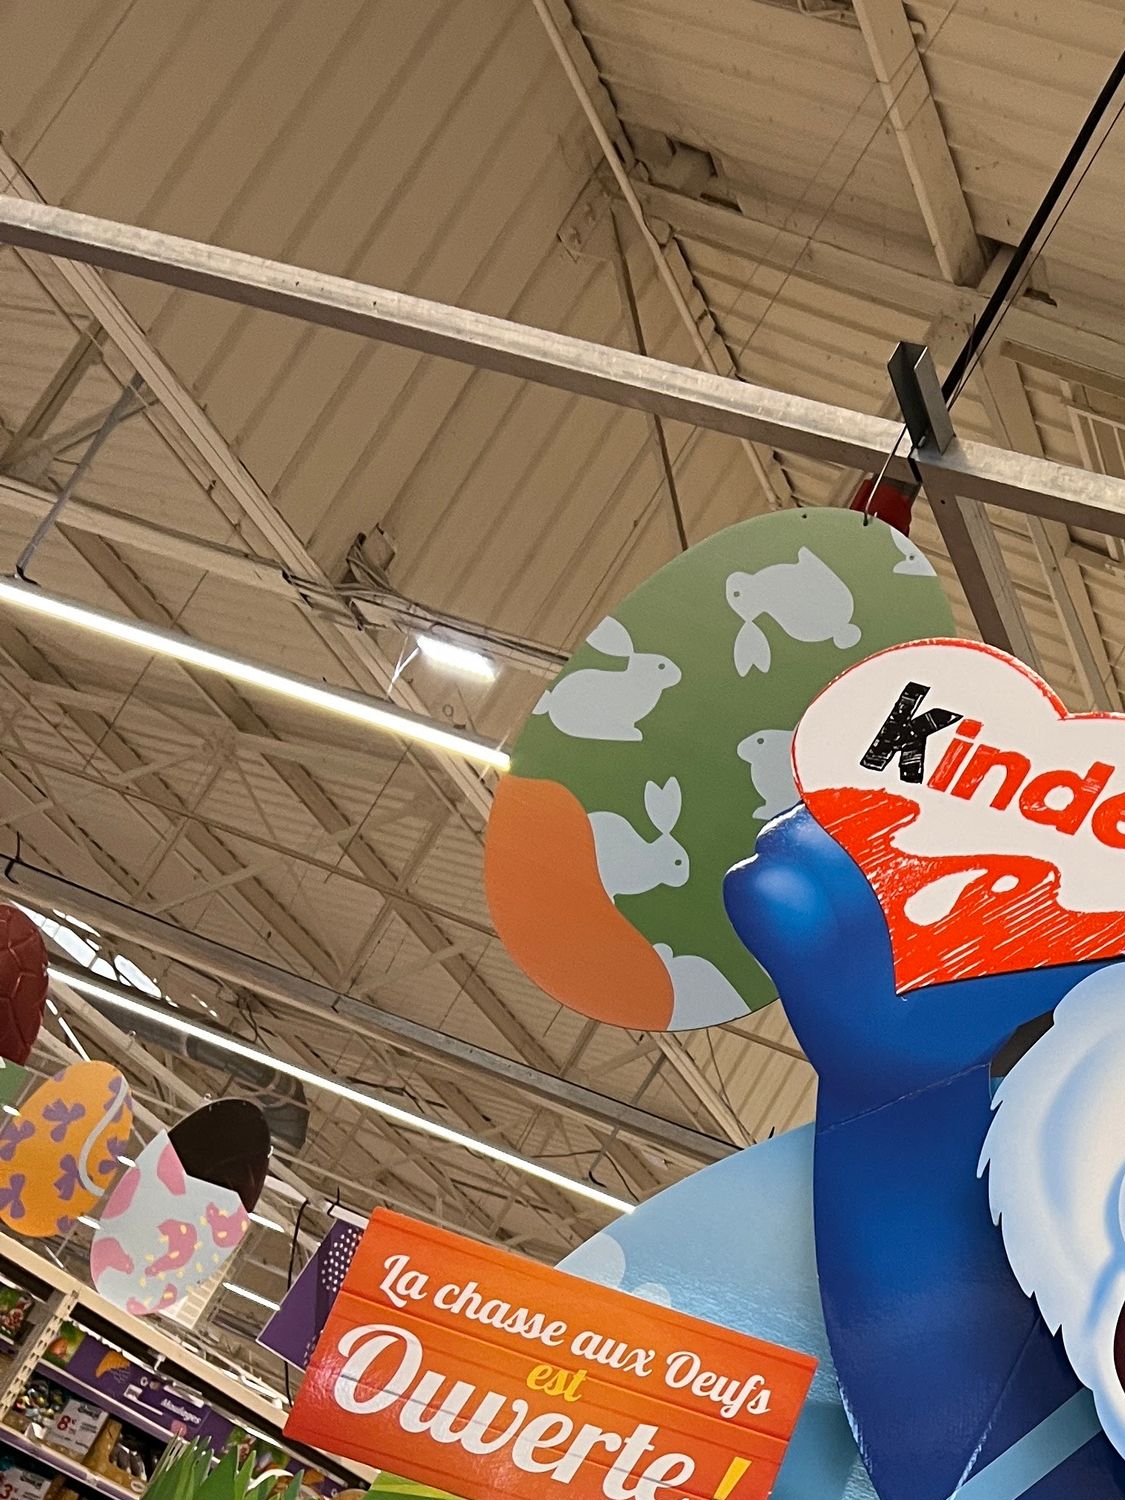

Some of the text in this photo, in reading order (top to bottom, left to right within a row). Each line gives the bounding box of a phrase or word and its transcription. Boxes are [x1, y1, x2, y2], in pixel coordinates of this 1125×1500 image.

[379, 1254, 772, 1420] La chasse aux Oeufs
[526, 1363, 587, 1402] est
